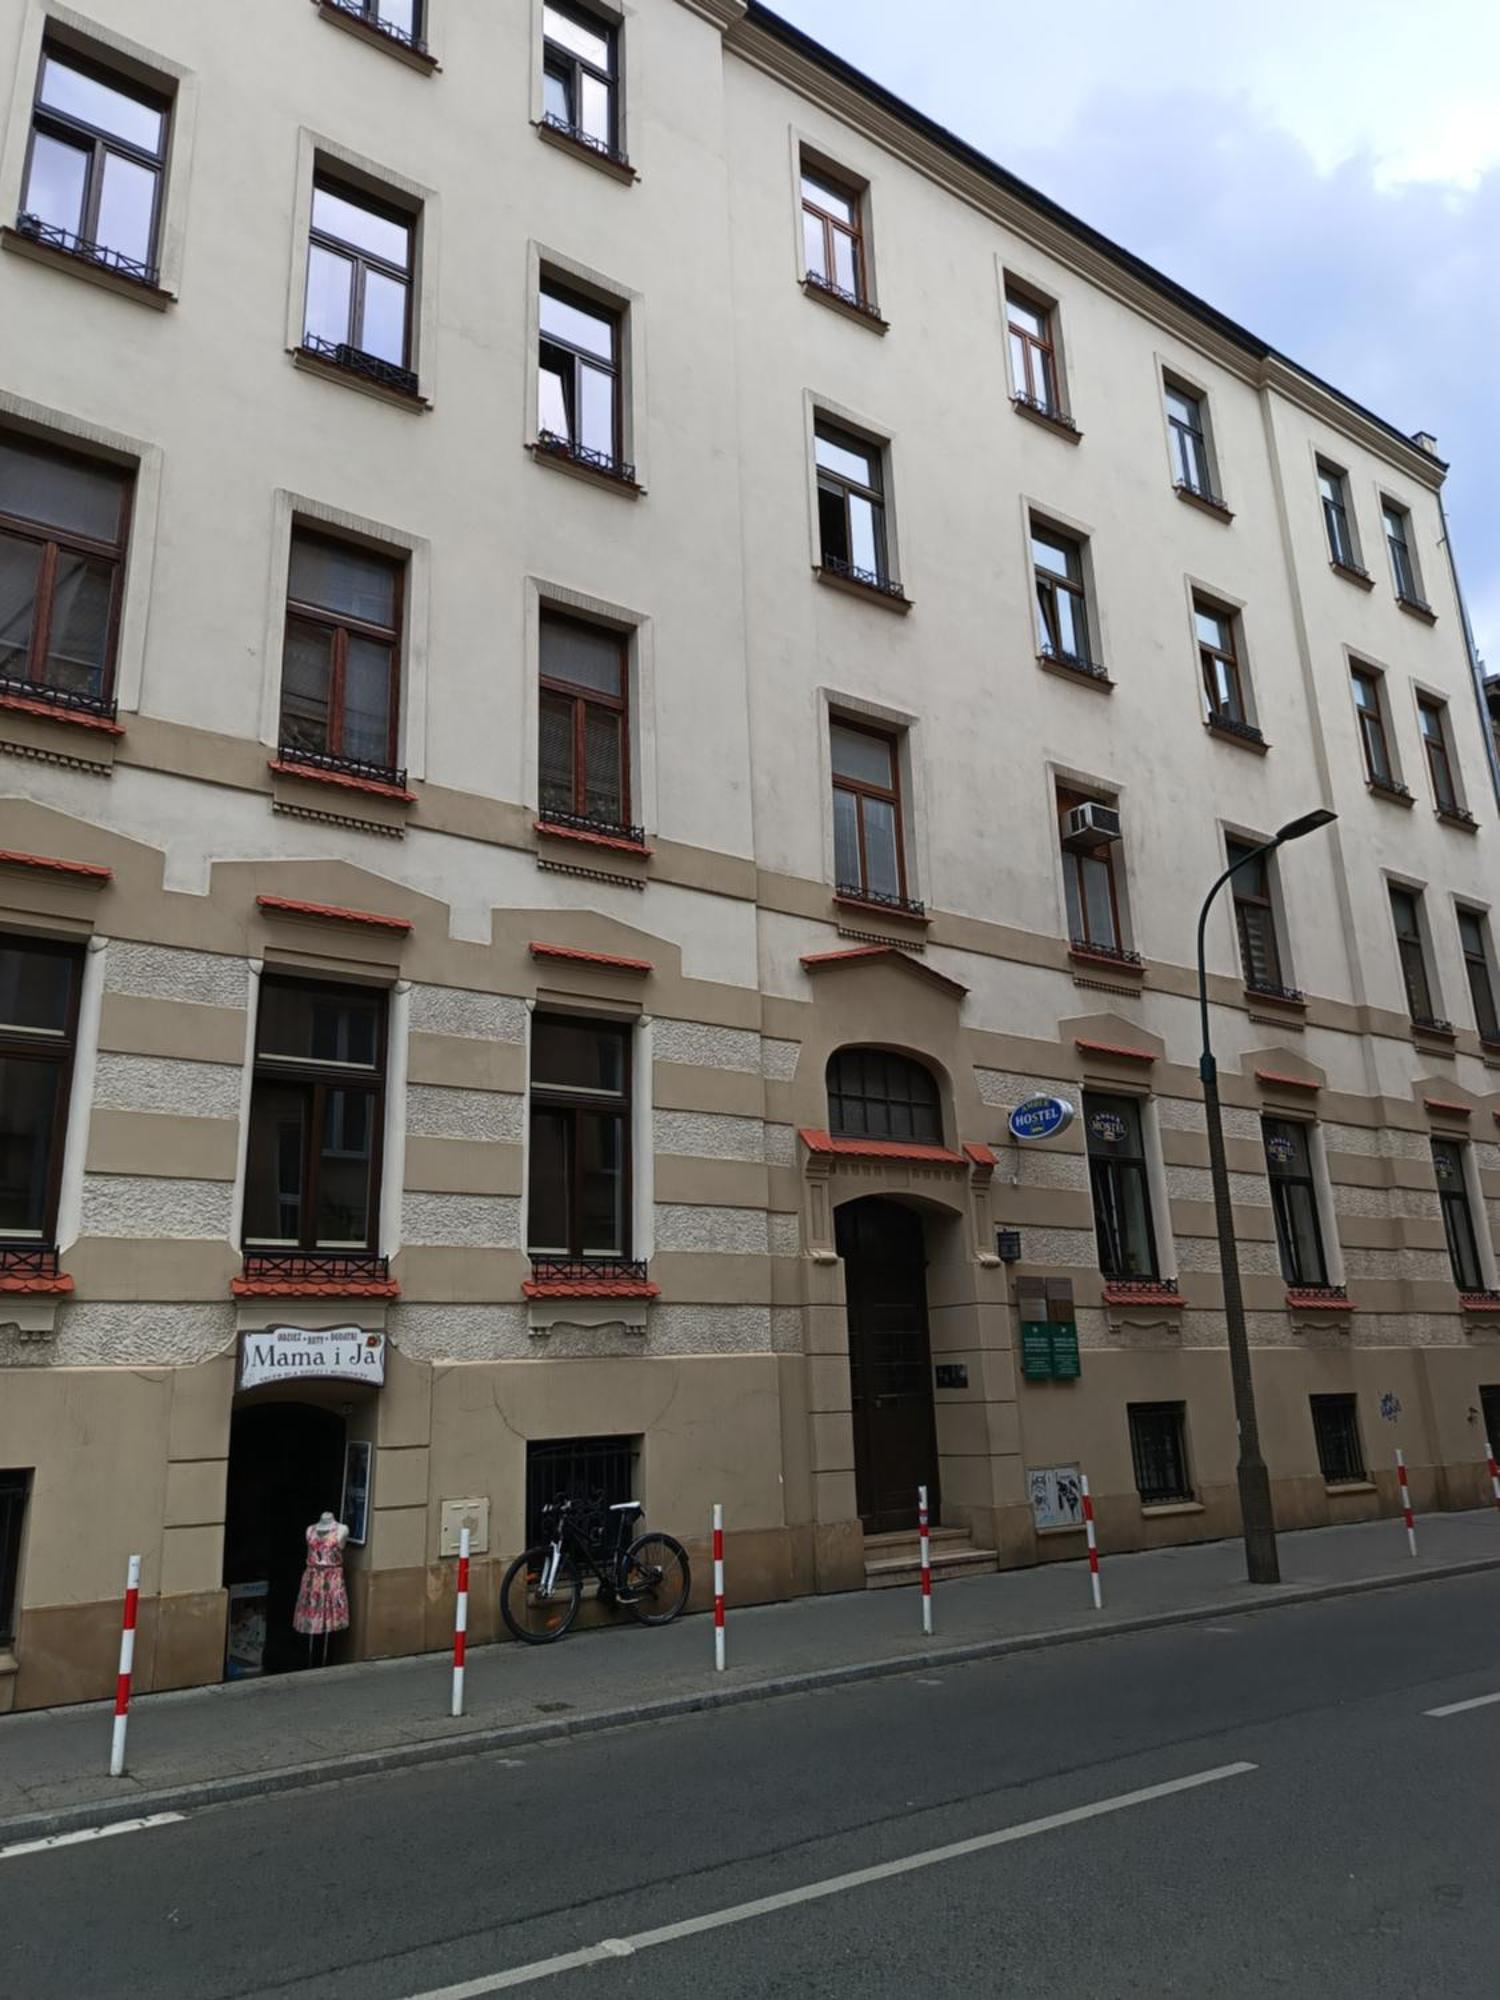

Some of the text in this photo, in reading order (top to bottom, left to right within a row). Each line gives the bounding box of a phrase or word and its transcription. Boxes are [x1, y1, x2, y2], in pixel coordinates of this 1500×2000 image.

[1015, 1108, 1059, 1127] HOSTEL
[251, 1343, 376, 1367] Mama i Ja
